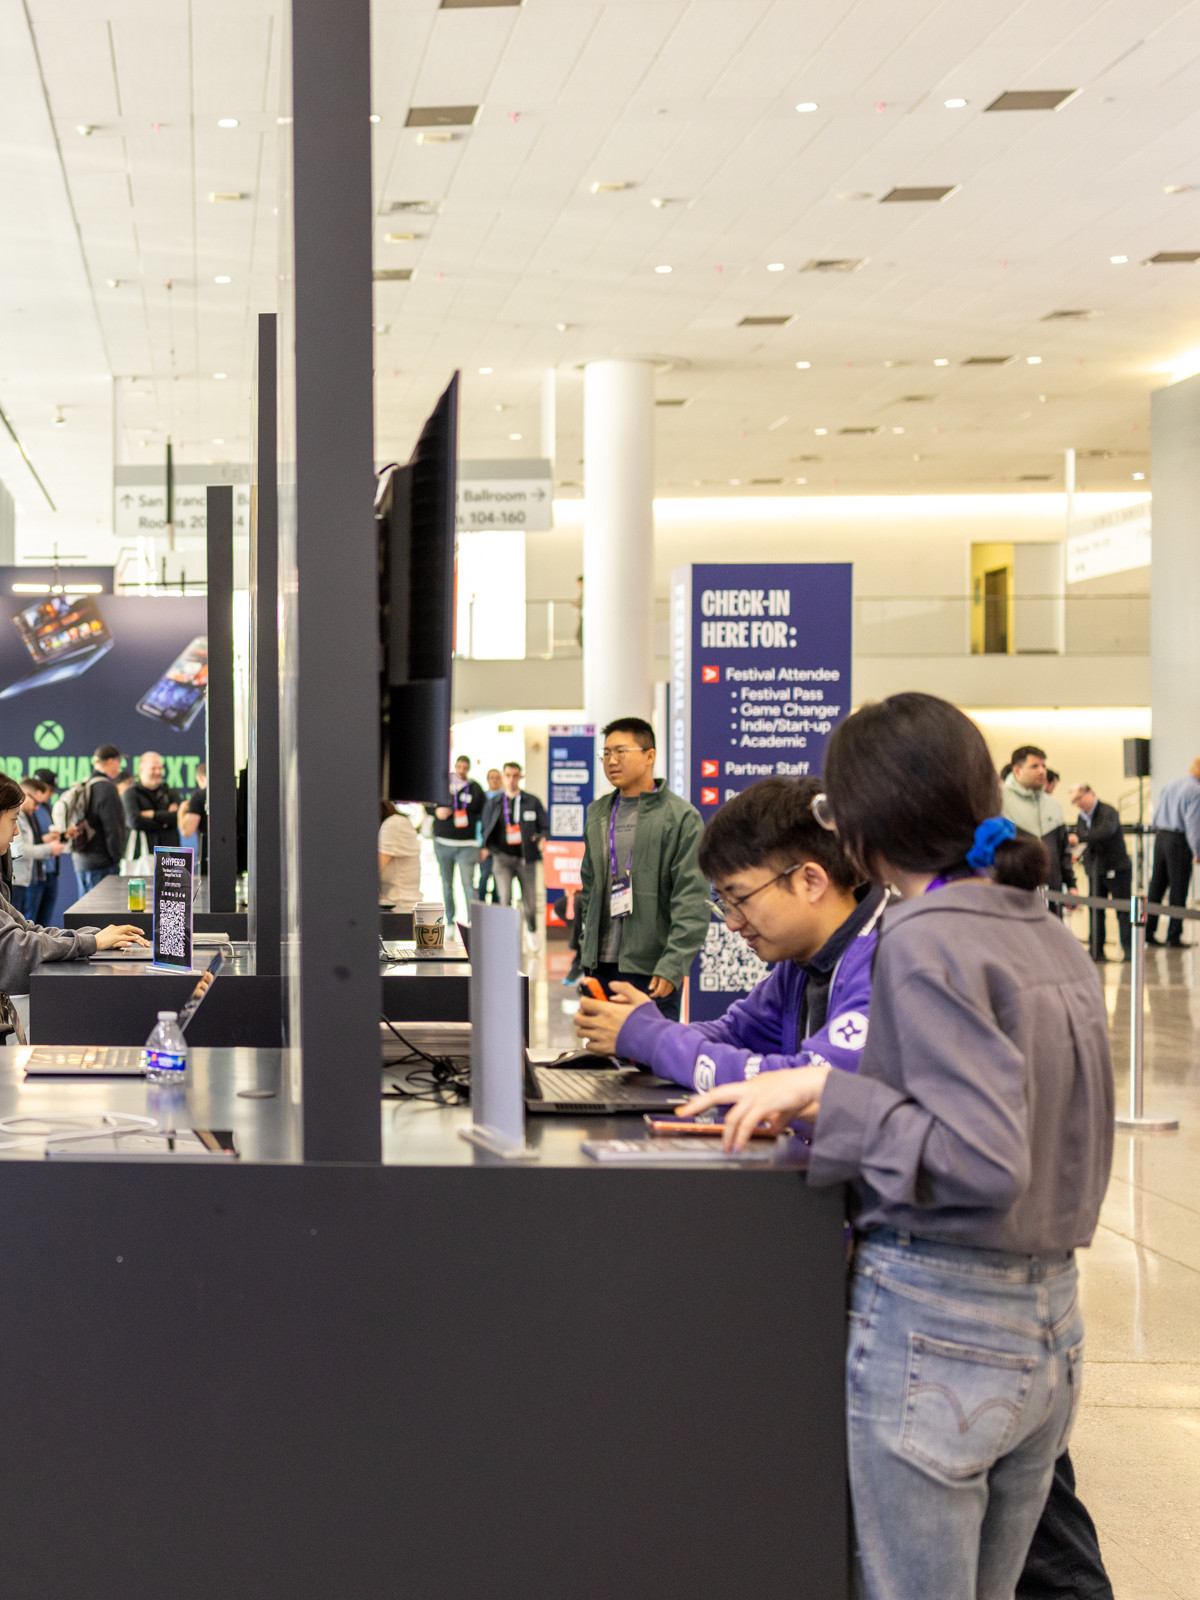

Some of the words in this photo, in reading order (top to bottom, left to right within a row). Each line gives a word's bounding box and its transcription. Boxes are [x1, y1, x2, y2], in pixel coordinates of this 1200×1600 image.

[701, 589, 791, 617] CHECK-IN
[701, 621, 749, 648] HERE
[674, 582, 685, 714] FESTIVAL
[725, 667, 776, 681] Festival
[777, 667, 840, 681] Attendee
[740, 687, 791, 701] Festival
[793, 687, 824, 701] Pass
[740, 703, 781, 717] Game
[783, 703, 841, 719] Changer
[740, 719, 832, 735] Indie/Start-up
[740, 734, 807, 748] Academic
[725, 761, 774, 775] Partner
[776, 761, 810, 775] Staff
